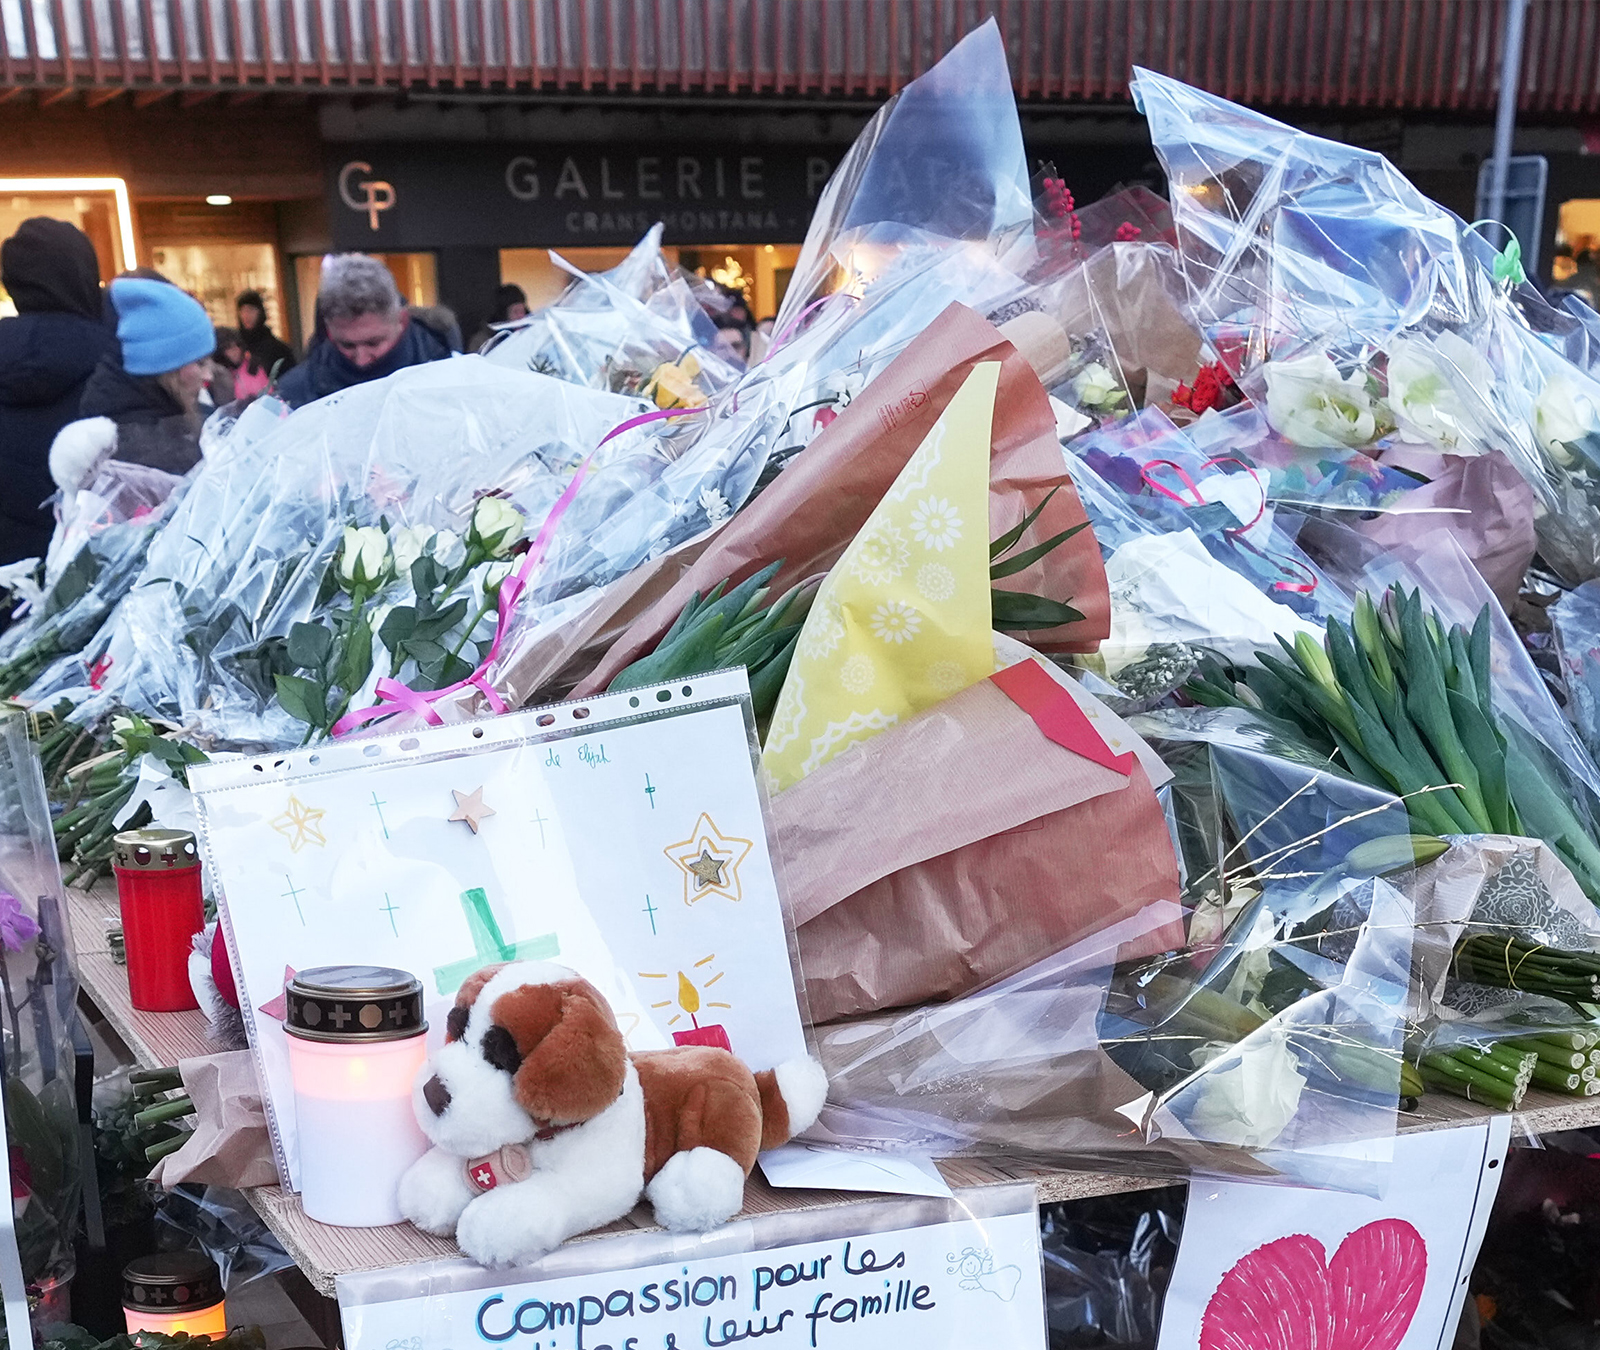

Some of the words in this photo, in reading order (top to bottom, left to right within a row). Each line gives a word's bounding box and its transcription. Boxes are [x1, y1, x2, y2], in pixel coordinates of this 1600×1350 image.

[505, 155, 765, 200] GALERIE
[476, 1268, 737, 1345] Compassion
[753, 1254, 832, 1310] pour
[804, 1280, 937, 1347] famille
